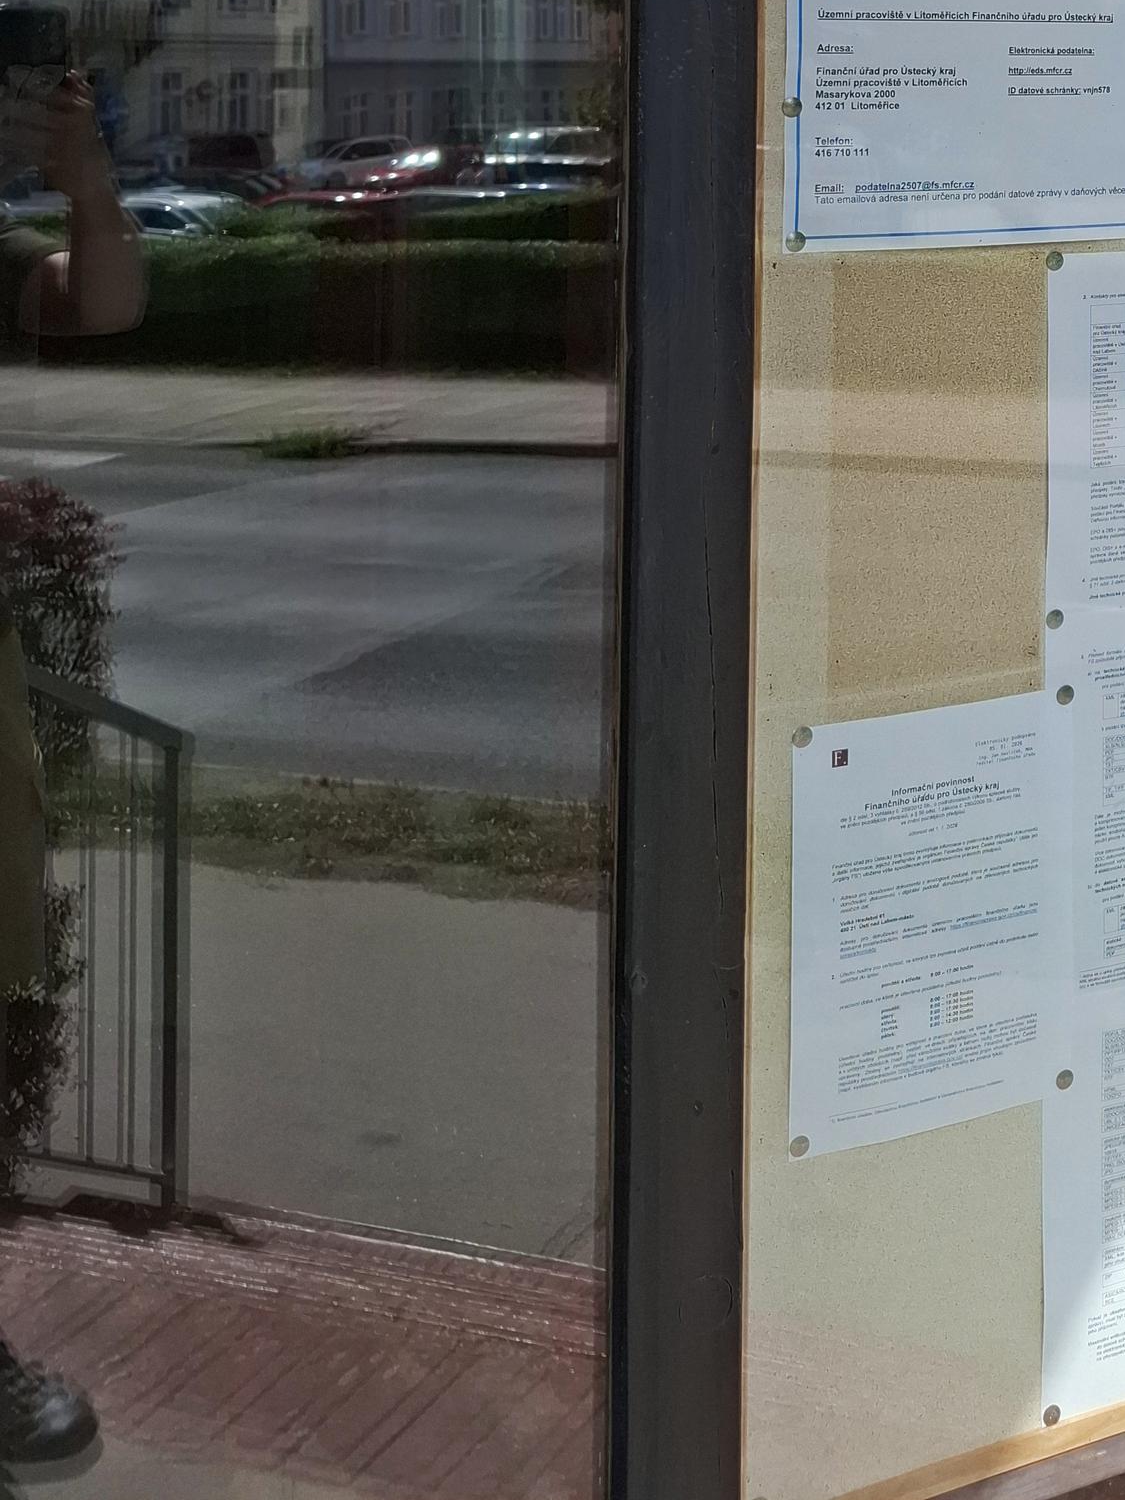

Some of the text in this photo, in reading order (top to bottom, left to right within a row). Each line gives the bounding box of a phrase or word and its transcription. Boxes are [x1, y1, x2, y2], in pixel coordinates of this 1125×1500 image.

[818, 8, 852, 18] Územní
[856, 10, 904, 20] pracoviště
[914, 10, 969, 20] Litoměřicích
[972, 12, 1019, 20] Finančního
[1022, 12, 1045, 21] úřadu
[1048, 14, 1062, 22] pro
[1064, 12, 1096, 22] Ústecký
[1099, 14, 1113, 23] kraj
[817, 44, 854, 52] Adresa:
[1057, 47, 1094, 55] podatelna:
[816, 67, 857, 75] Finanční
[860, 67, 880, 75] úřad
[901, 65, 936, 76] Ústecký
[940, 67, 956, 76] kraj
[816, 77, 850, 87] Územní
[854, 79, 901, 88] pracoviště
[912, 78, 968, 87] Litoměřicích
[816, 90, 895, 100] Masarykova 2000
[1046, 87, 1081, 95] schránky:
[815, 101, 900, 110] 412 01 Litoměřice
[816, 137, 853, 145] Telefon:
[815, 148, 869, 157] 416 710 111
[815, 180, 974, 193] Email: podatelna2507@fs.mfcr.cz
[815, 196, 834, 204] Tato
[879, 194, 908, 202] adresa
[911, 193, 929, 201] není
[932, 192, 960, 200] určena
[963, 193, 976, 201] pro
[891, 776, 975, 797] Informační povinnost
[865, 797, 910, 811] Finančního
[937, 791, 949, 800] pro
[985, 781, 1000, 791] kraj
